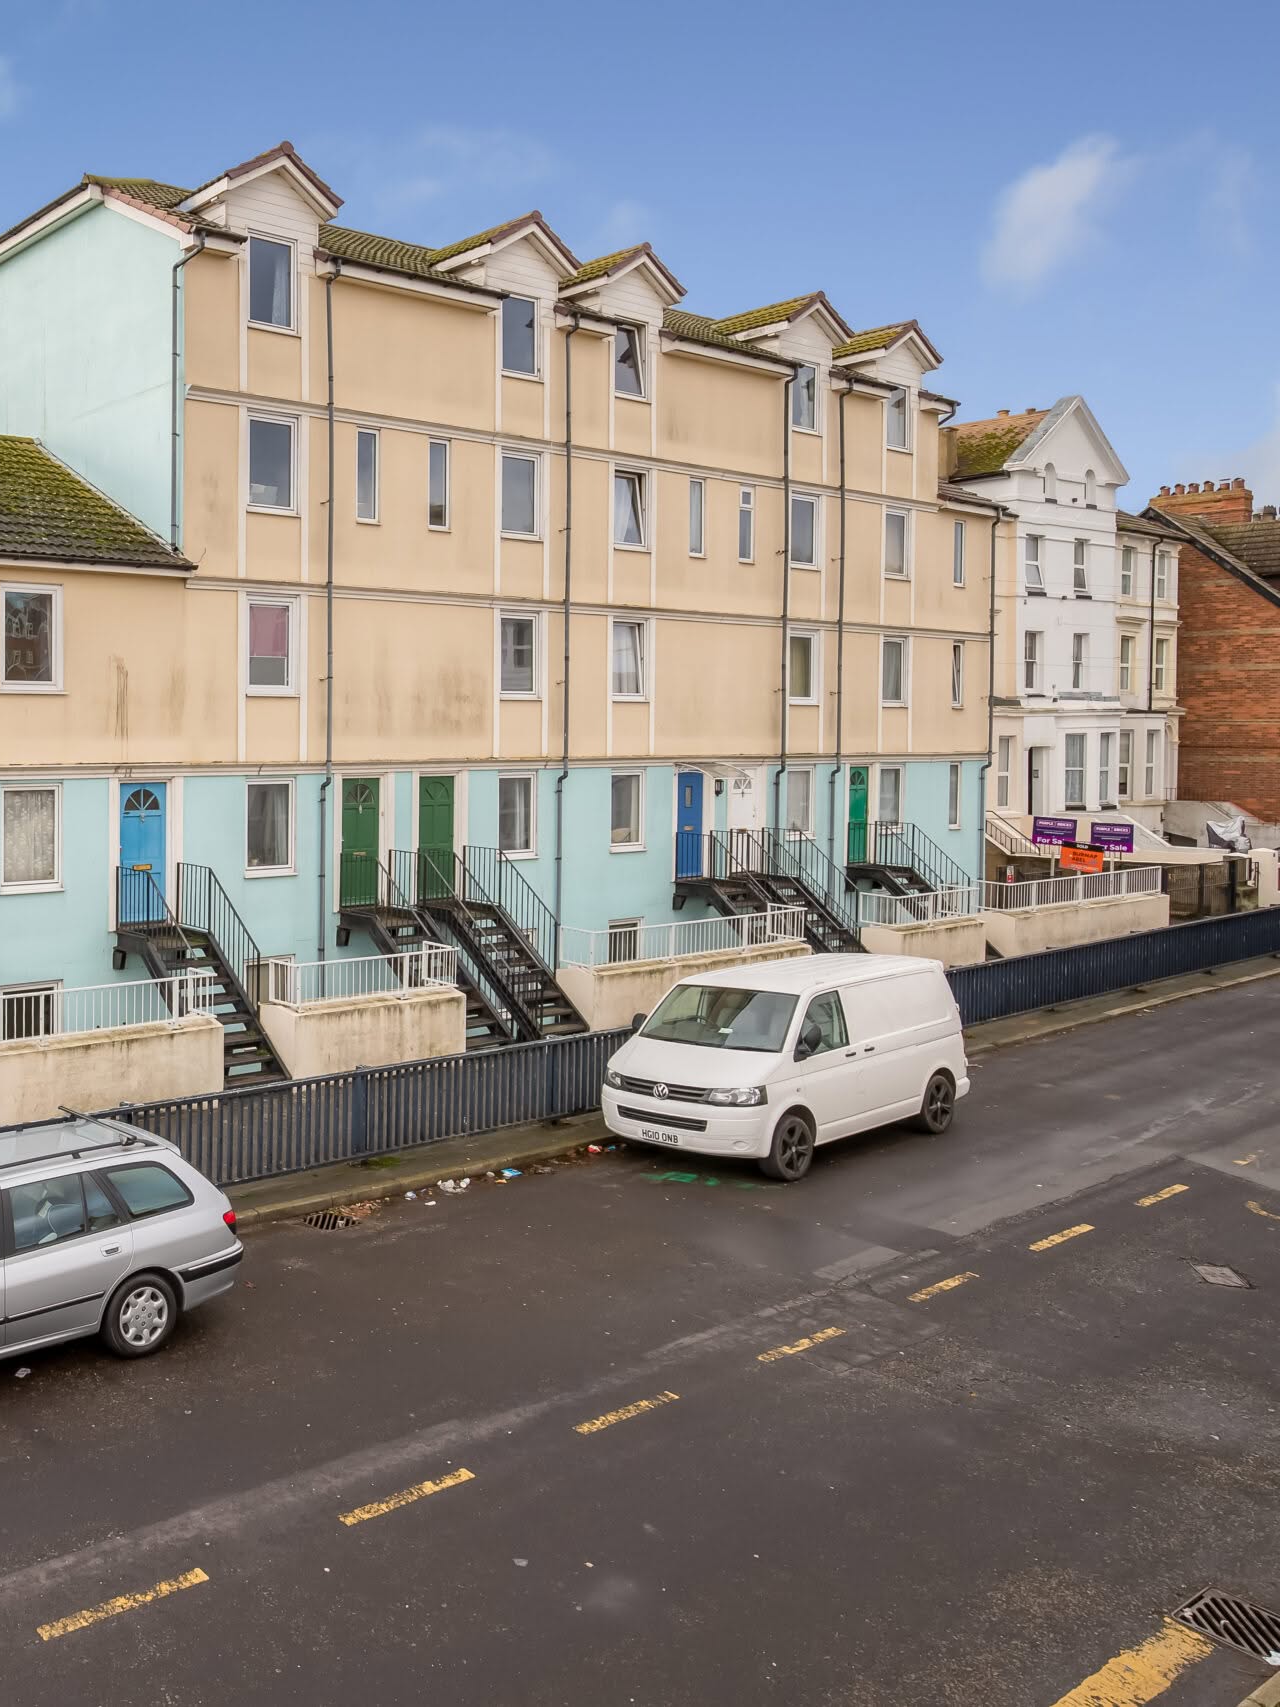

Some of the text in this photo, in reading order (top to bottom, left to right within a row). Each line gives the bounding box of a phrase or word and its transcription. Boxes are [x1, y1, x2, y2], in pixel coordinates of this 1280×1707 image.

[1036, 836, 1051, 844] For
[1109, 843, 1128, 851] Sale
[661, 1132, 679, 1144] ONB
